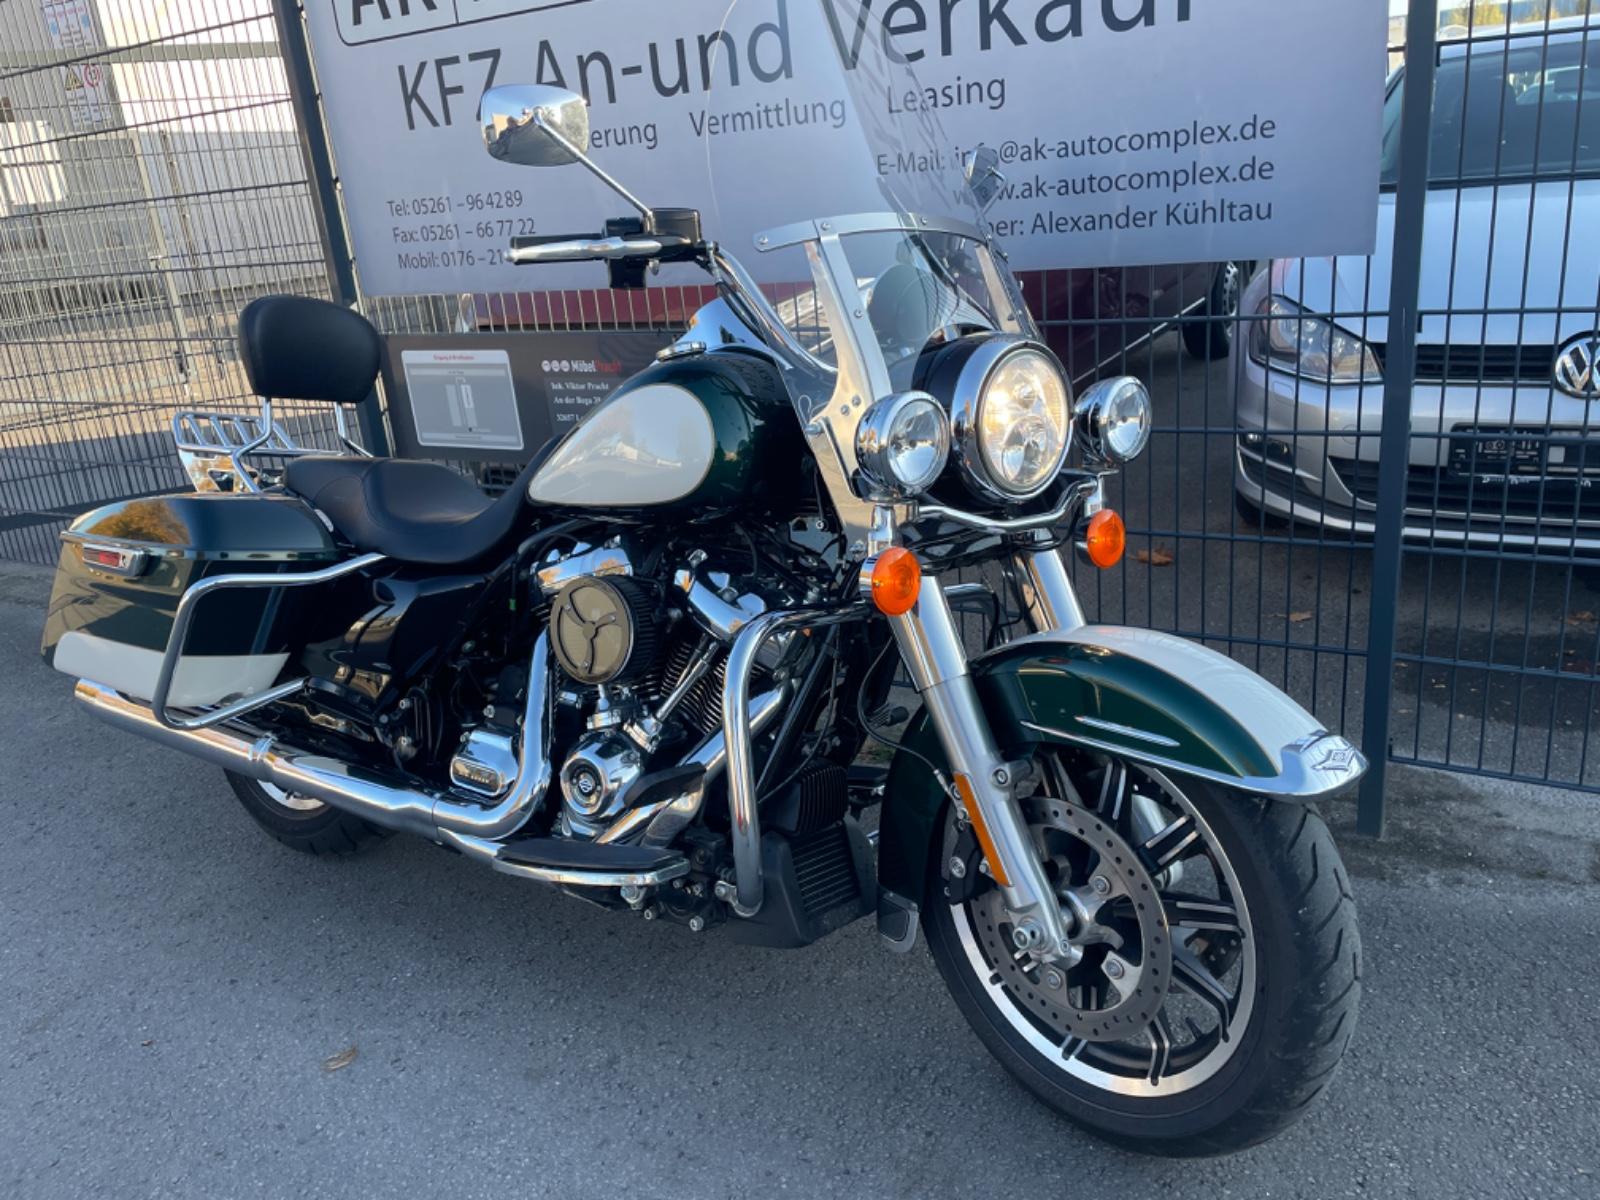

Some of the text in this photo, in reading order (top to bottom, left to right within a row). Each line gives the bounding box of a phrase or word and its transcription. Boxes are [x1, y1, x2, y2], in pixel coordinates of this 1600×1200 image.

[688, 98, 847, 138] Vermittlung
[887, 76, 1006, 115] Leasing
[876, 149, 946, 176] E-Mail:
[412, 196, 452, 215] 05261
[1031, 205, 1158, 235] Alexander
[1165, 198, 1272, 227] Kühltau
[420, 223, 461, 242] 05261
